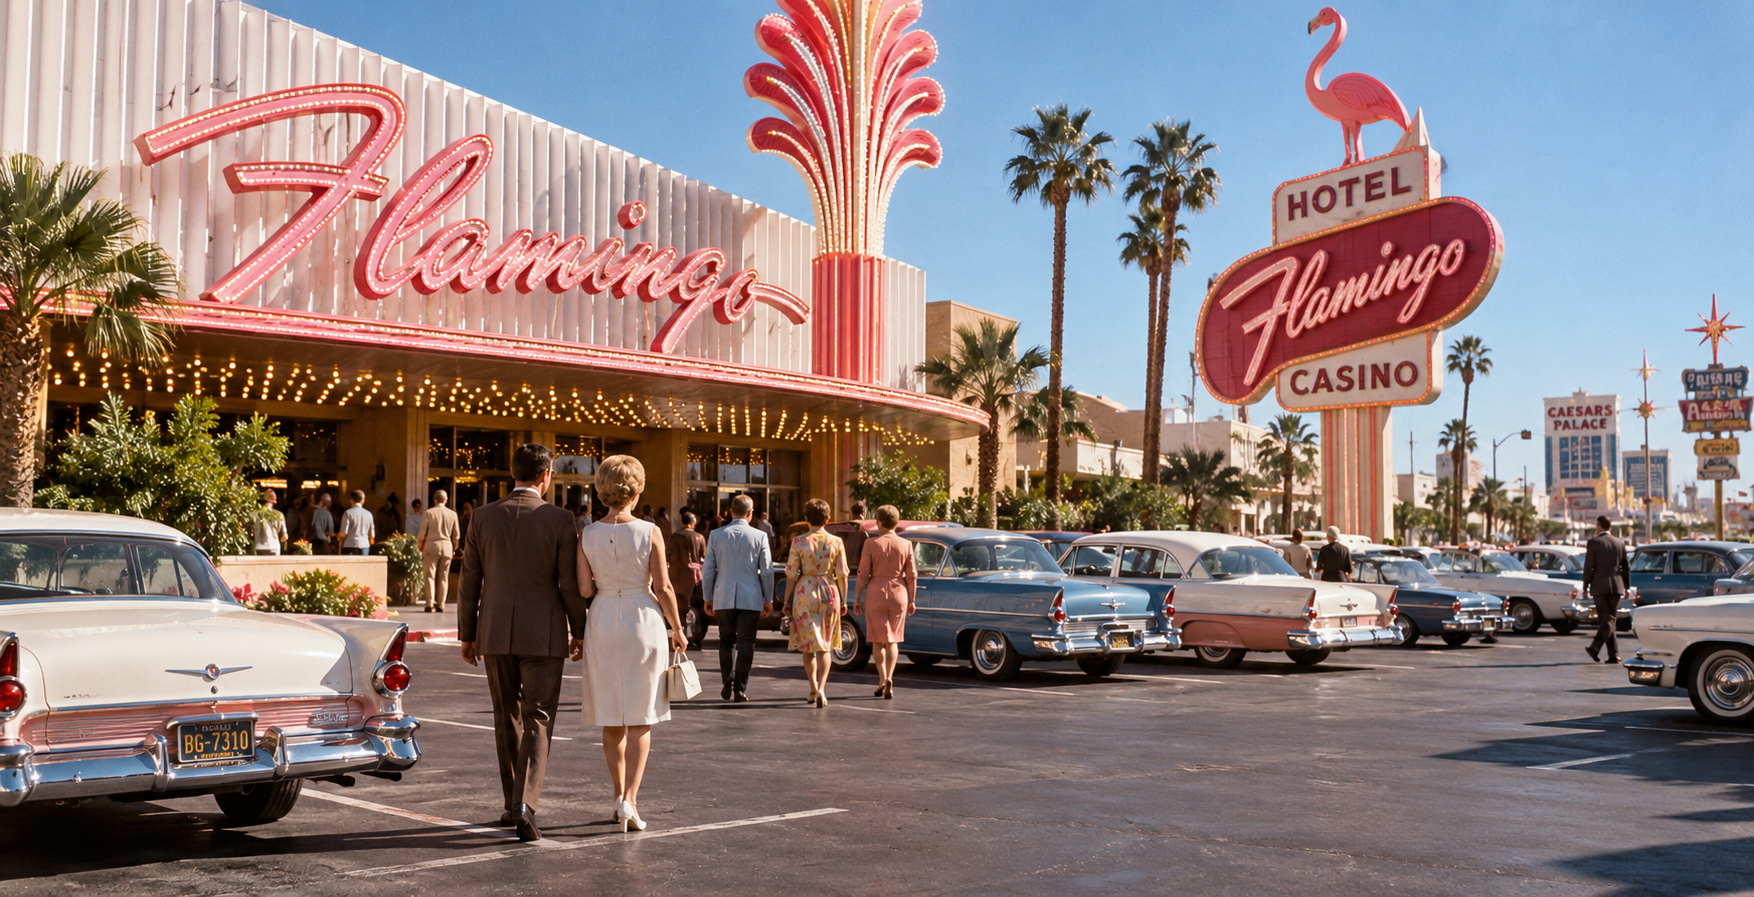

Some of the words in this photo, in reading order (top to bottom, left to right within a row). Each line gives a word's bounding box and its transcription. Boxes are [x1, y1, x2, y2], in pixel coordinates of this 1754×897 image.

[1287, 166, 1412, 221] HOTEL
[134, 82, 811, 354] Flamingo
[1218, 238, 1466, 386] Flamingo
[1289, 360, 1418, 396] CASINO
[1547, 404, 1613, 418] CAESARS
[1553, 418, 1607, 431] PALACE
[184, 730, 249, 754] BG-7310
